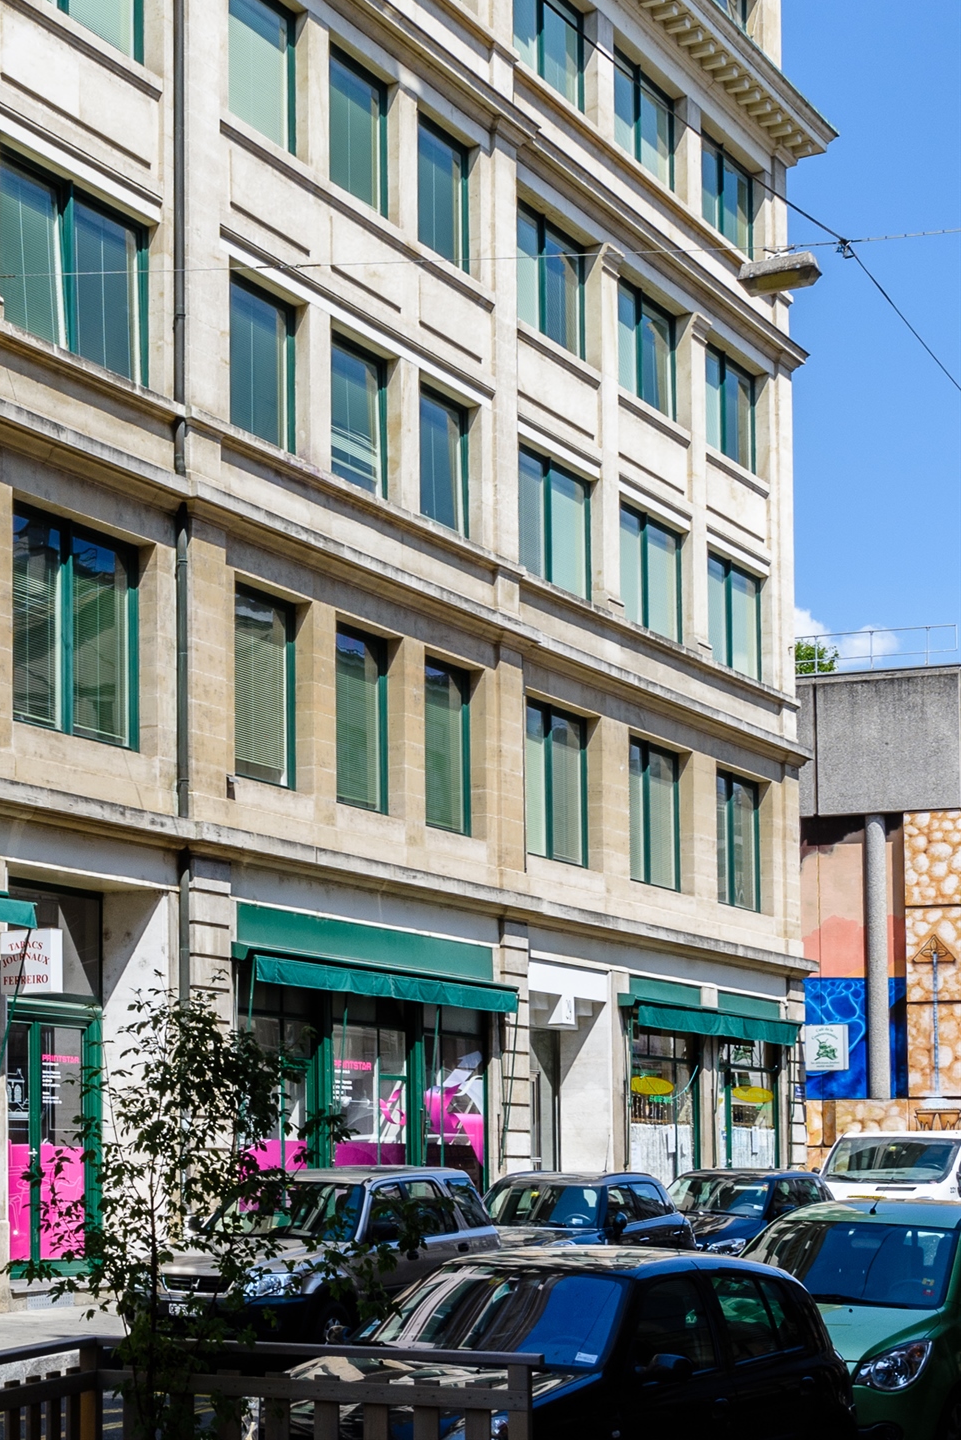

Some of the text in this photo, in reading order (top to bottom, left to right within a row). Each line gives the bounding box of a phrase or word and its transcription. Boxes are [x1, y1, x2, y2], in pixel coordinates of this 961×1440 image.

[8, 940, 44, 951] TABACS
[2, 952, 50, 968] JOURNAUX
[3, 974, 49, 986] FERREIRO
